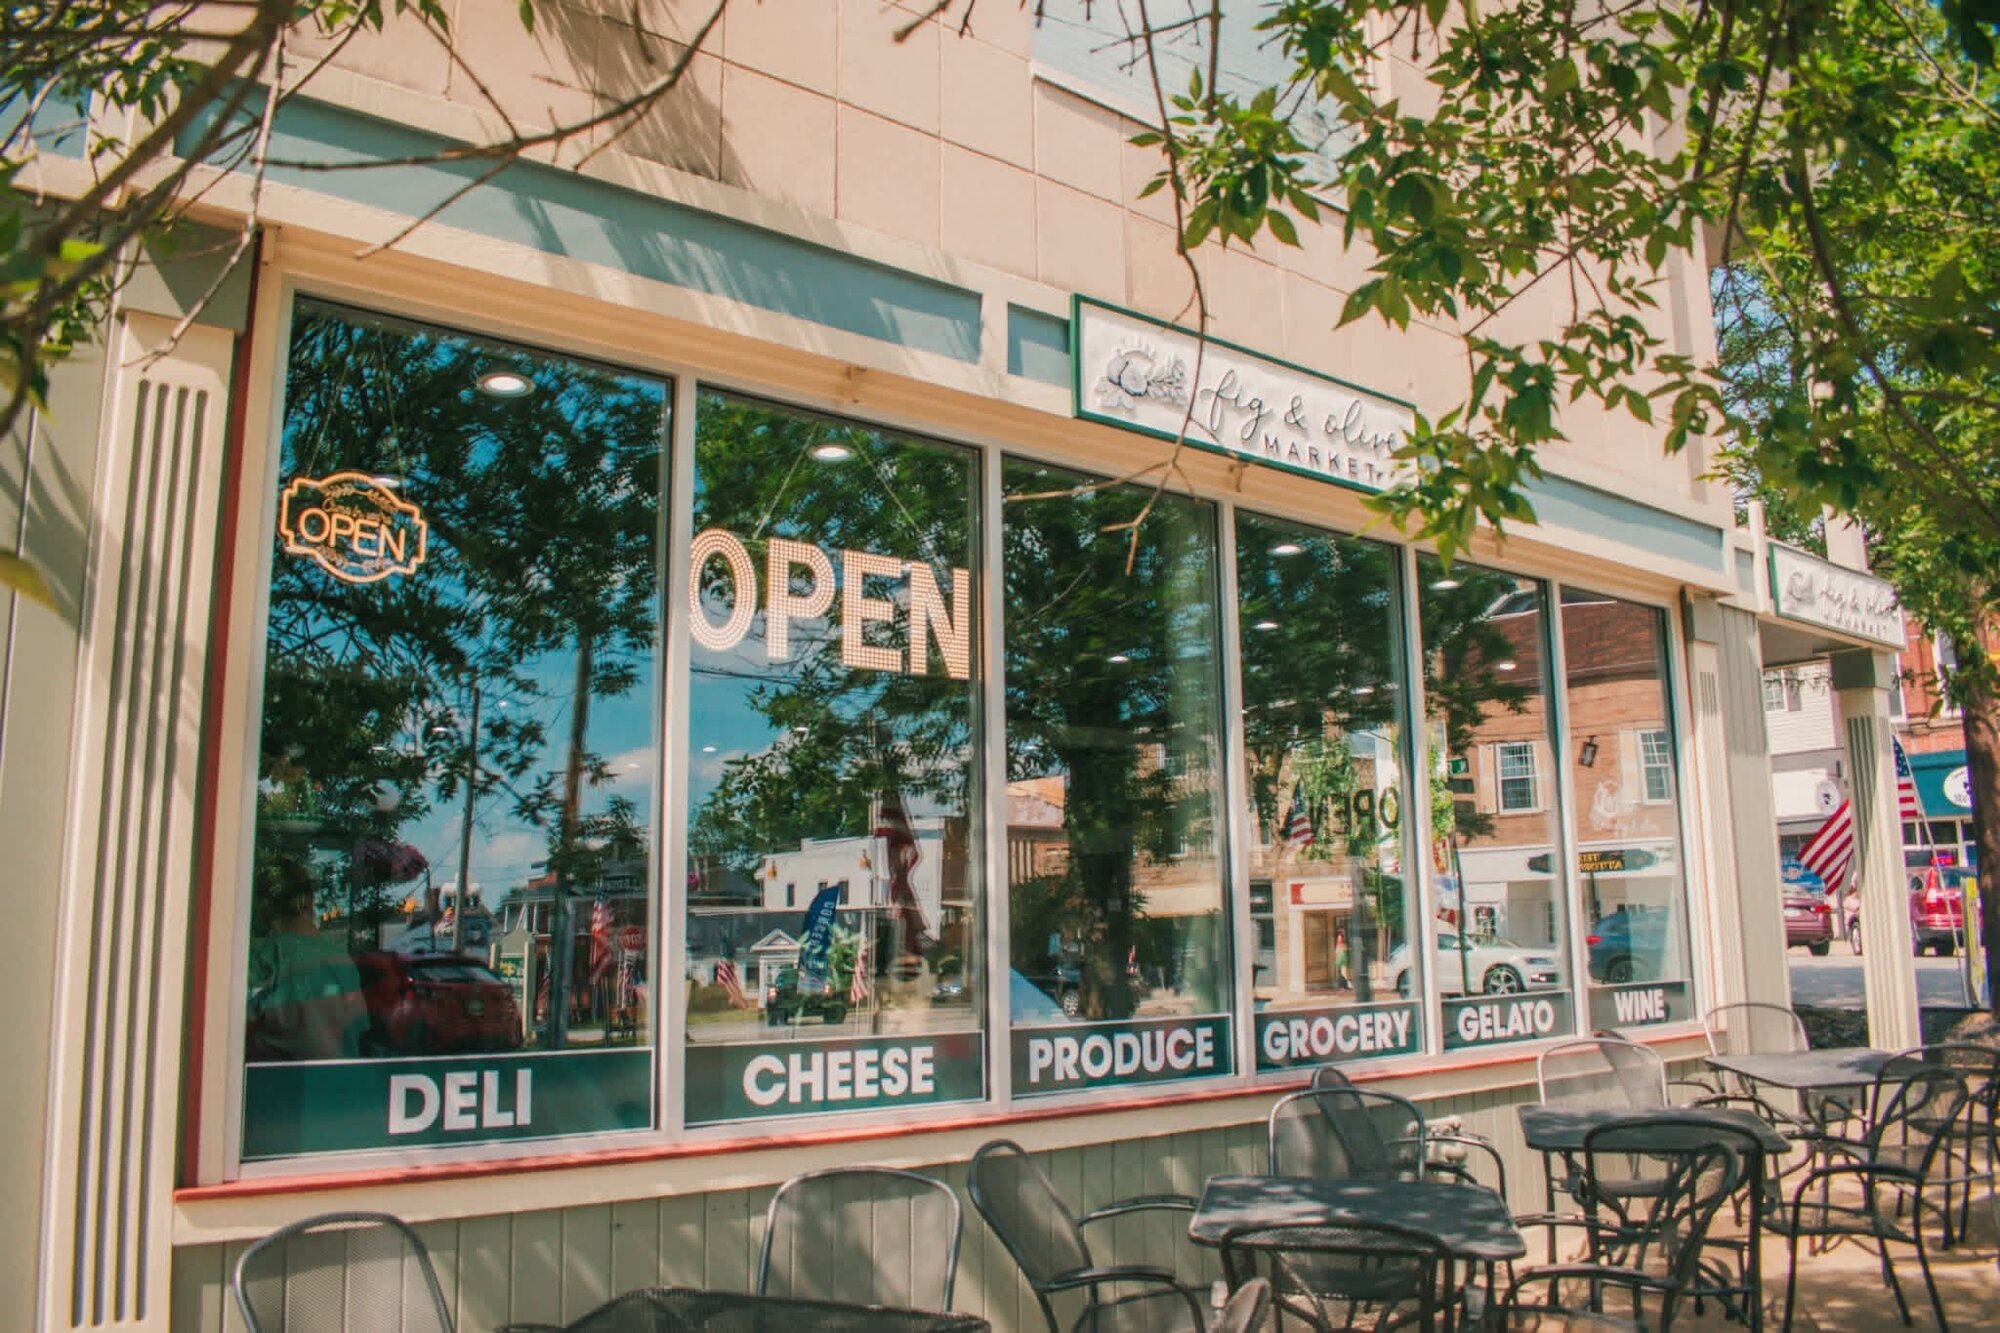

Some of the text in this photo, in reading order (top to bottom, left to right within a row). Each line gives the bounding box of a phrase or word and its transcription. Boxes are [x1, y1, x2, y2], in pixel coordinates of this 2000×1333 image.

[1200, 369, 1399, 453] fig & olive
[1264, 433, 1375, 482] MARKET
[298, 507, 406, 563] OPEN
[689, 528, 970, 680] OPEN
[1457, 1000, 1554, 1041] GELATO
[1614, 989, 1664, 1022] WINE
[1028, 1026, 1214, 1083] PRODUCE
[1263, 1009, 1410, 1060] GROCERY
[388, 1068, 532, 1135] DELI
[743, 1047, 934, 1106] CHEESE
